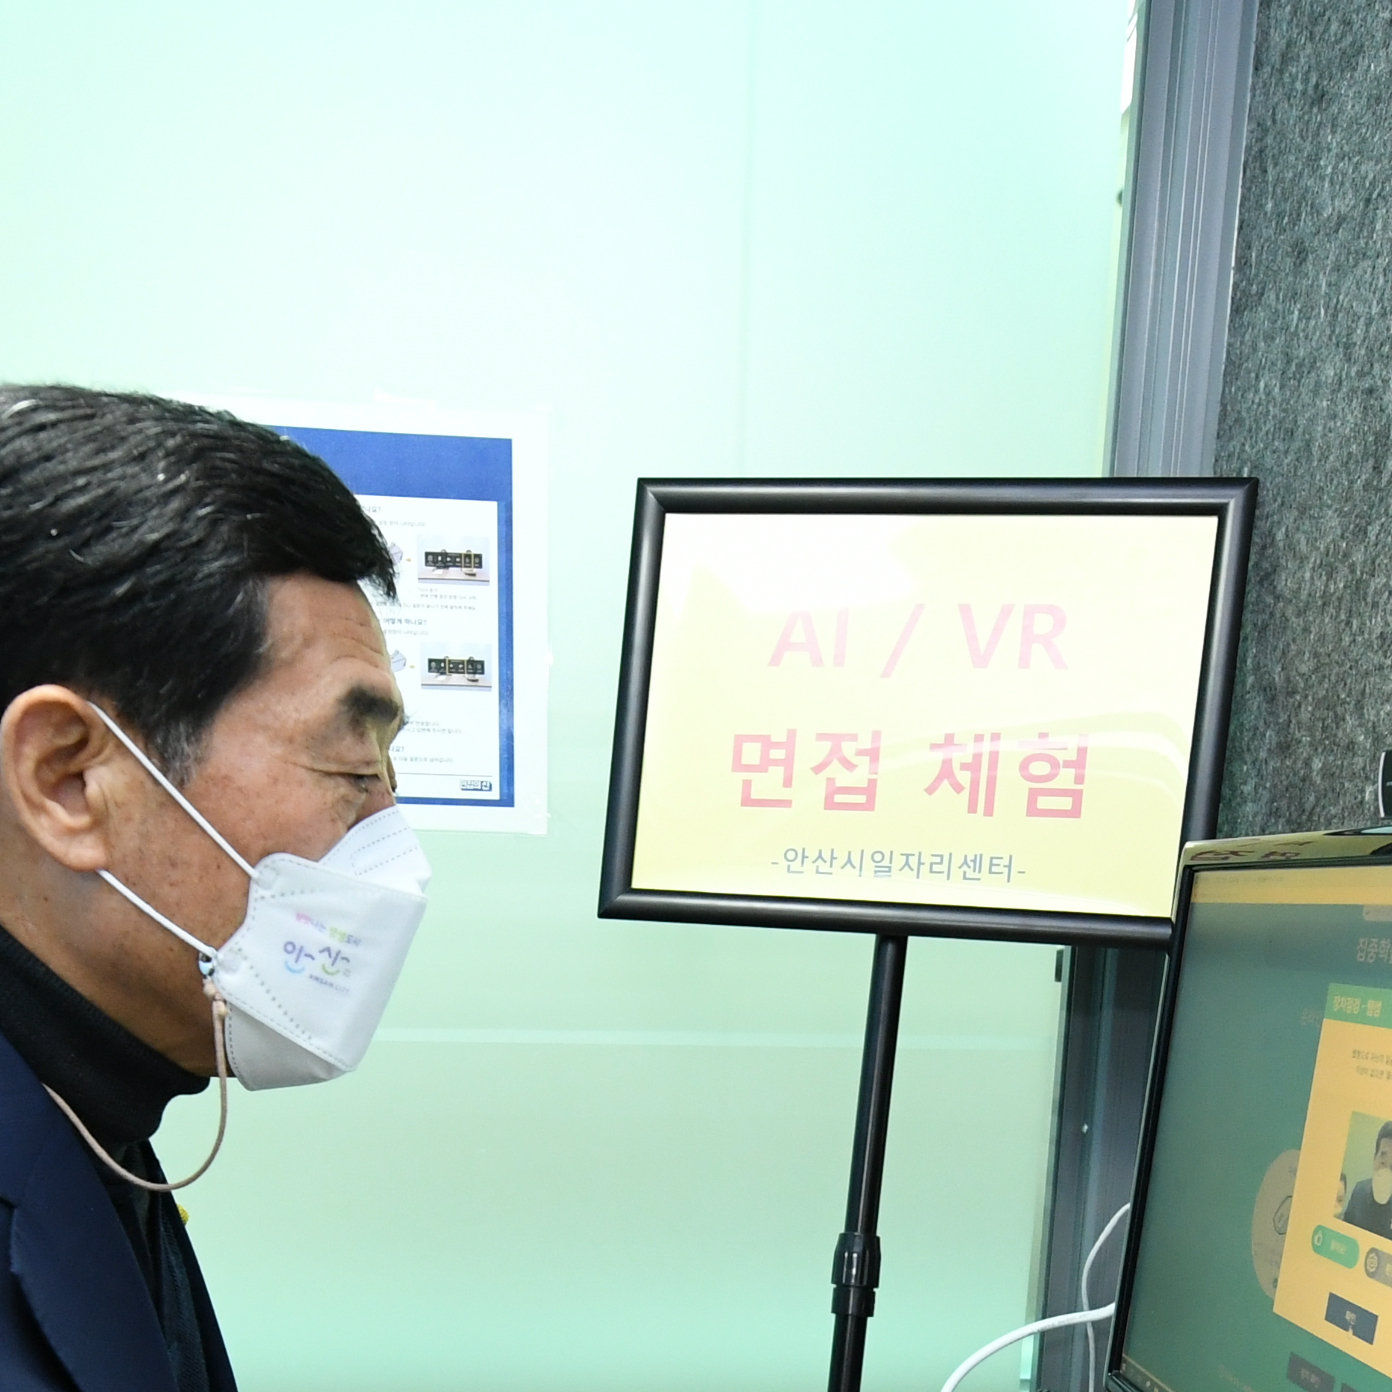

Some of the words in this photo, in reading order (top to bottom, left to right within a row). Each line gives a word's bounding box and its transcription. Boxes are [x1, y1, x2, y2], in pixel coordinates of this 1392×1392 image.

[767, 607, 850, 669] AI
[958, 603, 1069, 670] VR
[730, 728, 883, 812] 면접
[923, 732, 1090, 819] 체험
